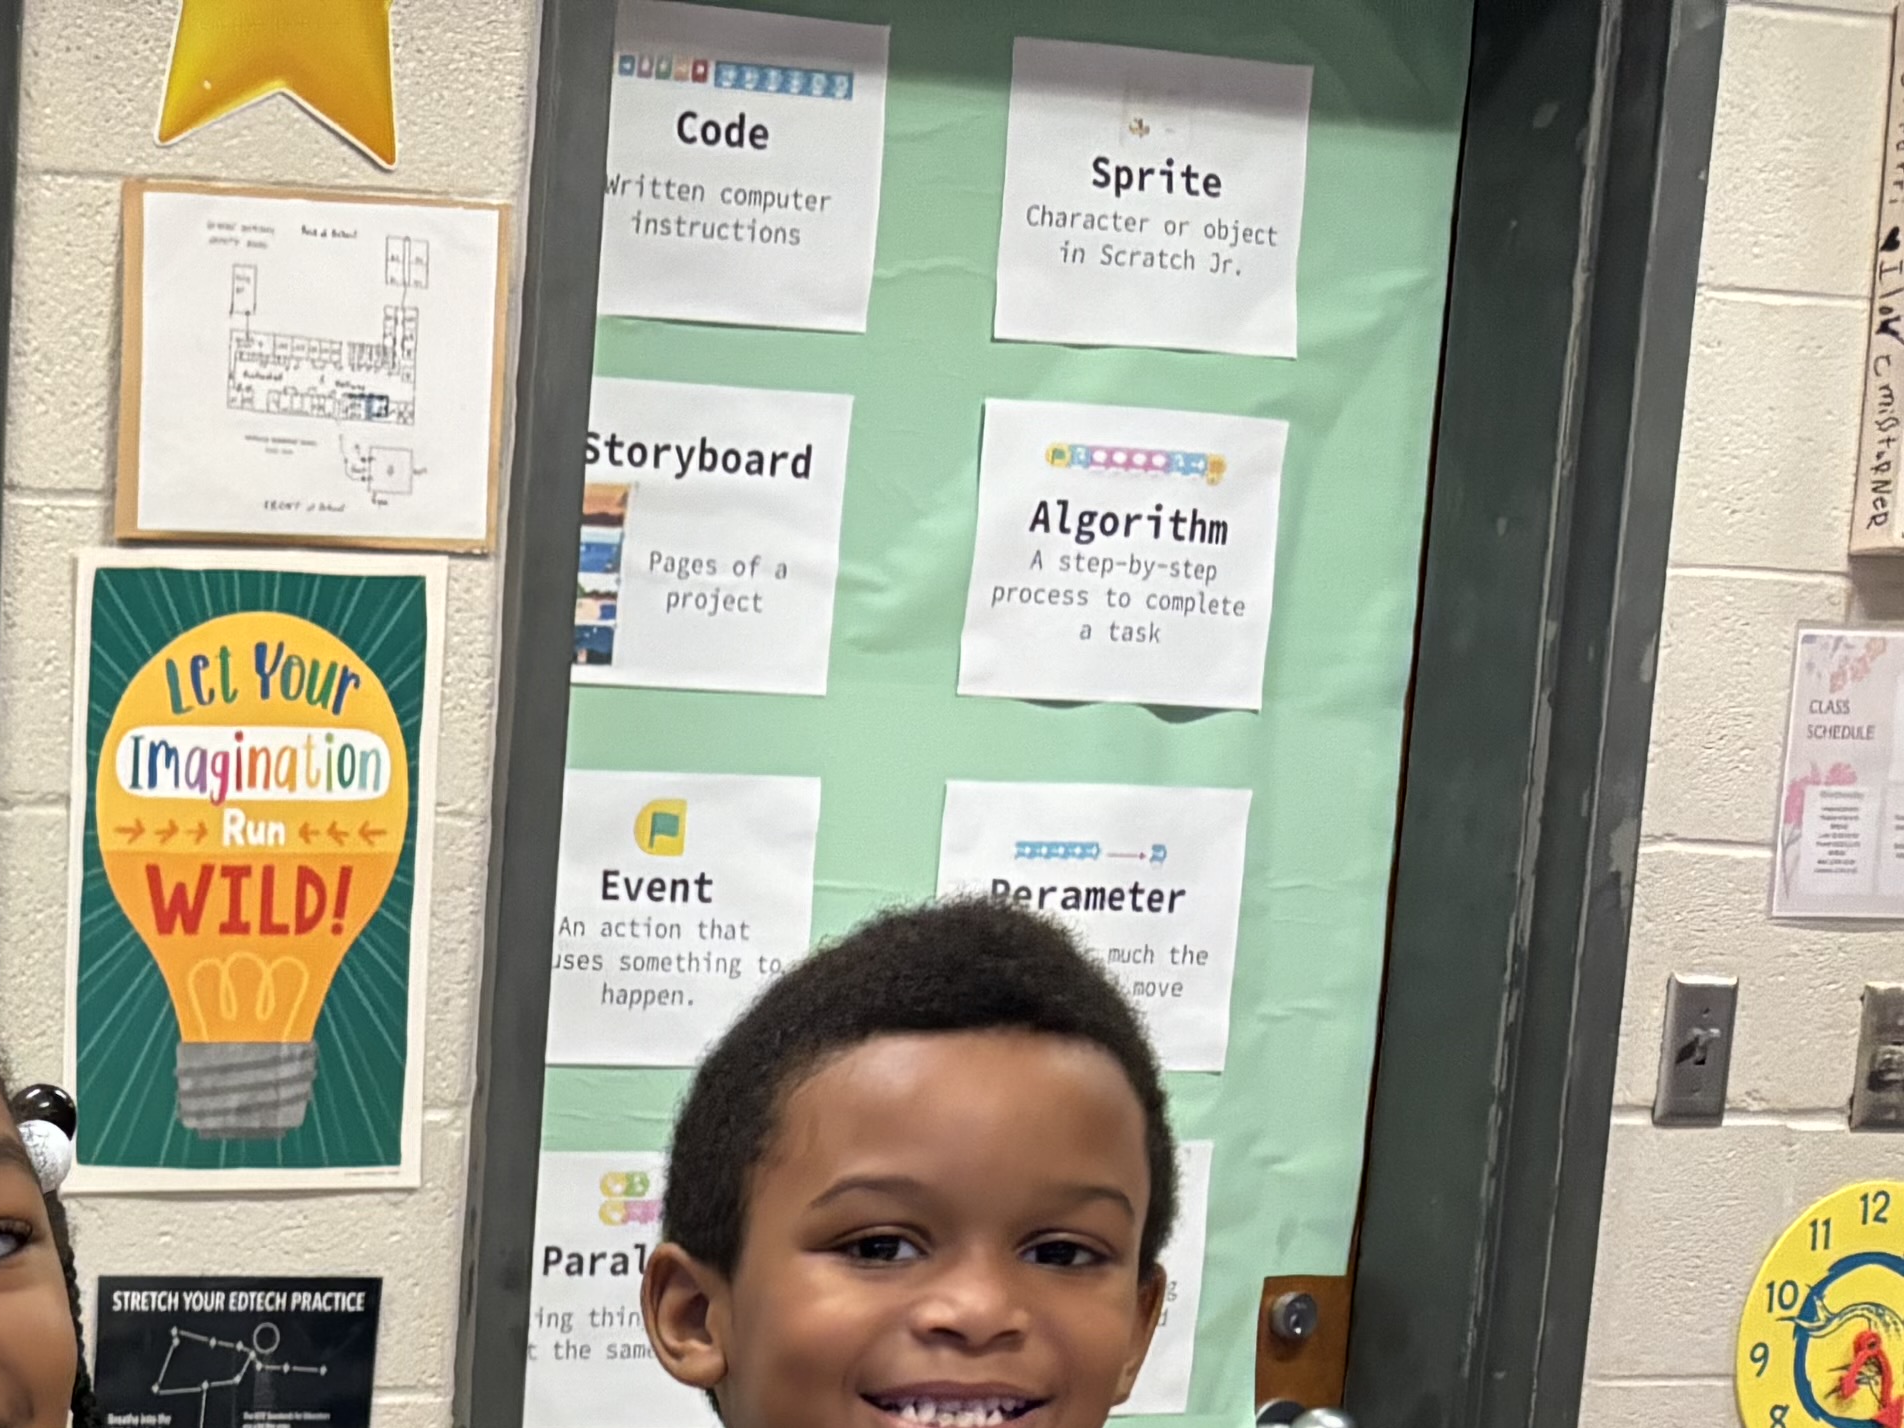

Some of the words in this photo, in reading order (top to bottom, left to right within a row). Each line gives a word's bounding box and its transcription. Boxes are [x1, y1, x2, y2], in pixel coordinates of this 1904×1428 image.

[676, 110, 769, 150] Code
[1092, 156, 1222, 198] Sprite
[605, 174, 705, 203] Written
[720, 184, 832, 214] computer
[632, 210, 801, 246] instructions
[1026, 204, 1150, 235] Character
[1164, 218, 1190, 236] or
[1203, 219, 1279, 248] object
[1060, 241, 1085, 264] in
[1100, 244, 1195, 272] Scratch
[1209, 252, 1242, 277] Jr.
[585, 431, 813, 480] Storyboard
[1030, 499, 1228, 545] Algorithm
[649, 550, 717, 579] Pages
[733, 555, 761, 578] of
[775, 561, 788, 579] a
[1030, 550, 1043, 571] A
[1059, 551, 1217, 586] step-by-step
[666, 589, 763, 616] project
[991, 584, 1088, 607] process
[1106, 588, 1131, 608] to
[1146, 591, 1245, 617] complete
[1079, 623, 1092, 640] a
[1109, 620, 1161, 644] task
[165, 645, 239, 715] Let
[255, 641, 360, 716] Your
[1809, 700, 1850, 715] CLASS
[1807, 724, 1875, 740] SCHEDULE
[129, 731, 382, 806] Imagination
[222, 808, 286, 846] Run
[146, 864, 353, 936] WILD!
[601, 869, 713, 903] Event
[558, 916, 585, 937] An
[600, 917, 682, 940] action
[698, 918, 750, 941] that
[620, 951, 742, 978] something
[758, 955, 781, 974] to
[1108, 944, 1154, 965] much
[1170, 944, 1208, 965] the
[601, 982, 694, 1011] happen.
[1132, 981, 1183, 998] move
[1859, 1190, 1891, 1225] 12
[1809, 1217, 1832, 1250] 11
[543, 1244, 645, 1277] Paral
[112, 1290, 179, 1312] STRETCH
[183, 1290, 226, 1312] YOUR
[228, 1291, 286, 1312] EDTECH
[290, 1291, 366, 1312] PRACTICE
[1766, 1280, 1799, 1313] 10
[537, 1307, 574, 1333] ing
[589, 1307, 642, 1329] thin
[554, 1341, 591, 1361] the
[1750, 1342, 1769, 1377] 9
